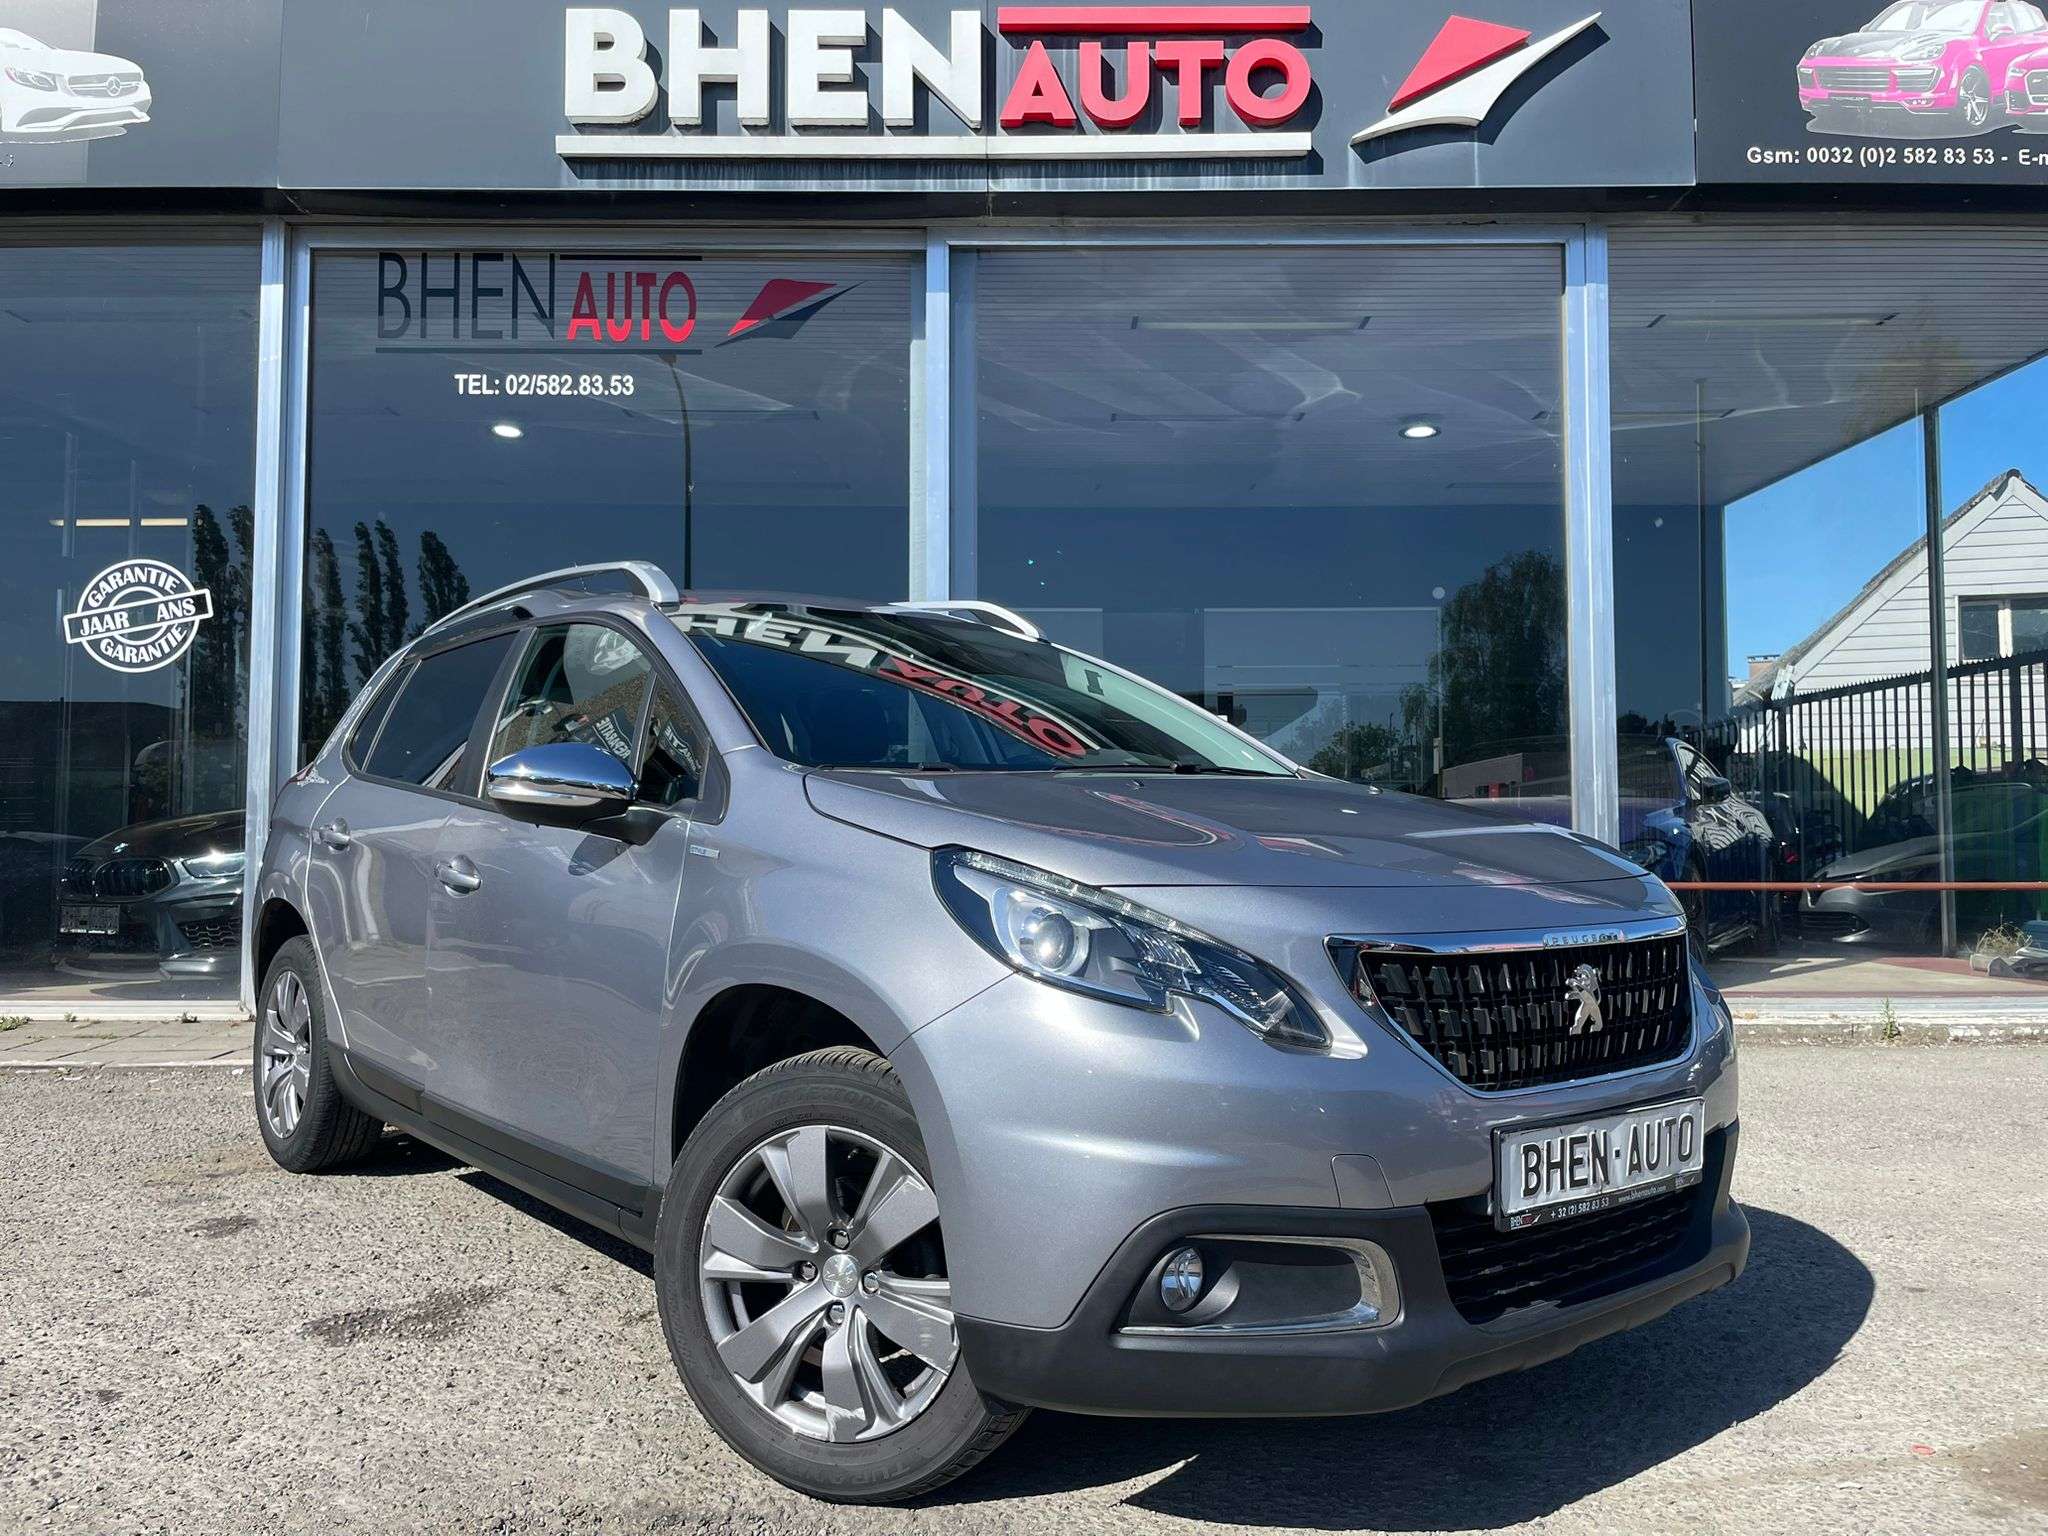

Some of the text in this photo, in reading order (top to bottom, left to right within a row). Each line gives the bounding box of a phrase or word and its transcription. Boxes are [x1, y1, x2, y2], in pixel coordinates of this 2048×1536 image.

[1746, 146, 1800, 164] Gsm:
[1806, 147, 1853, 164] 0032
[1859, 146, 1897, 168] (0)2
[1903, 147, 1938, 165] 582
[1943, 148, 1967, 165] 83
[1972, 148, 1995, 165] 53
[377, 252, 698, 343] BHEN AUTO
[454, 373, 635, 396] TEL: 02/582.83.53
[87, 566, 180, 608] GARANTIE
[80, 597, 197, 636] JAAR ANS
[100, 623, 188, 664] GARANTIE
